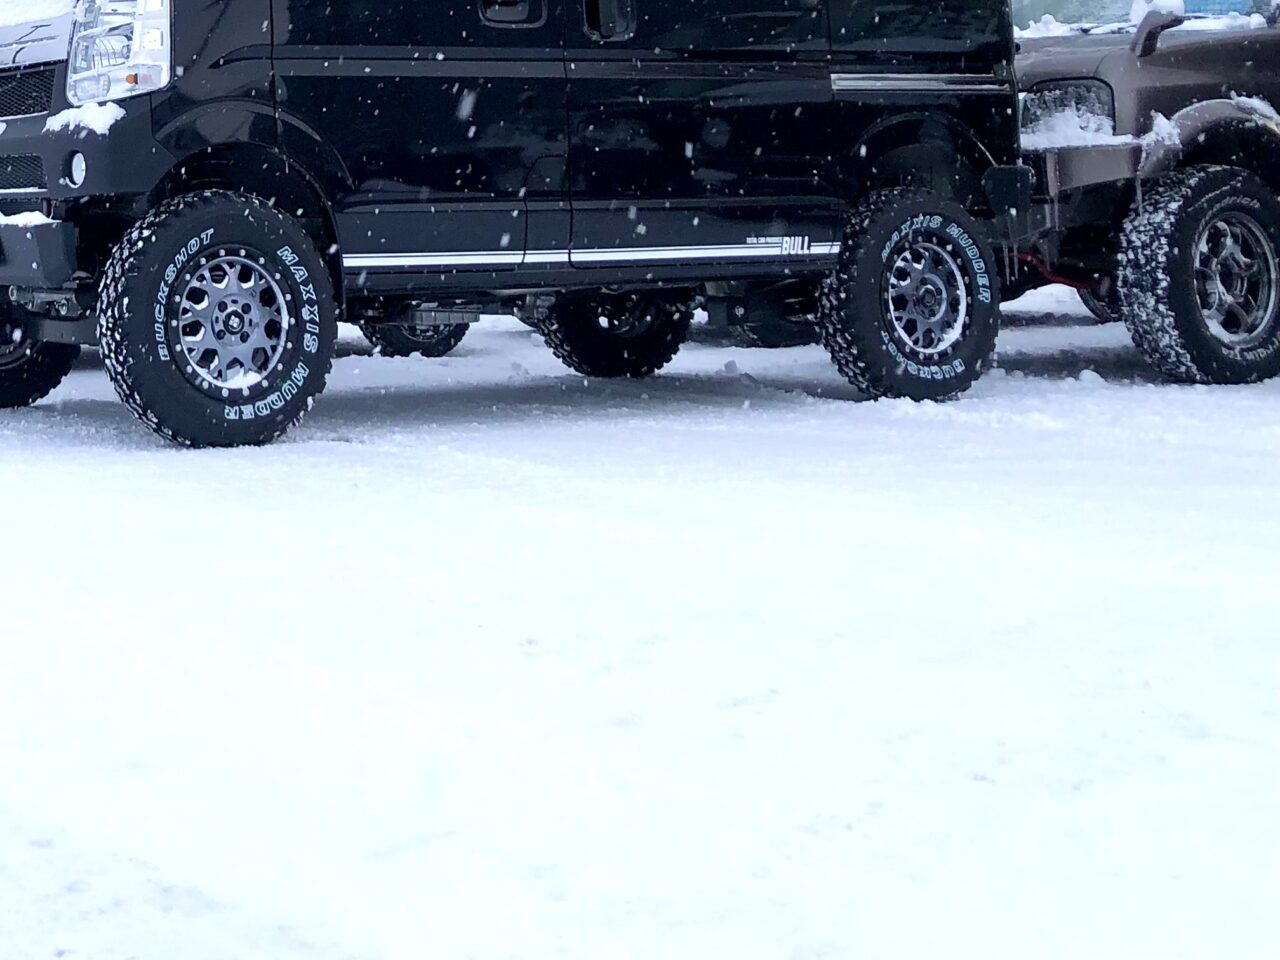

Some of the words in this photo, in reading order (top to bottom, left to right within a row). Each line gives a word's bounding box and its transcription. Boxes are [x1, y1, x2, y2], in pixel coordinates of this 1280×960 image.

[782, 236, 809, 255] BULL
[881, 214, 942, 262] MAXXIS
[946, 223, 992, 303] MUDDER
[154, 228, 214, 360] BUCKSHOT
[277, 246, 319, 353] MAXXIS
[224, 362, 309, 420] MUDDER
[881, 330, 965, 379] BUCKSHOT
